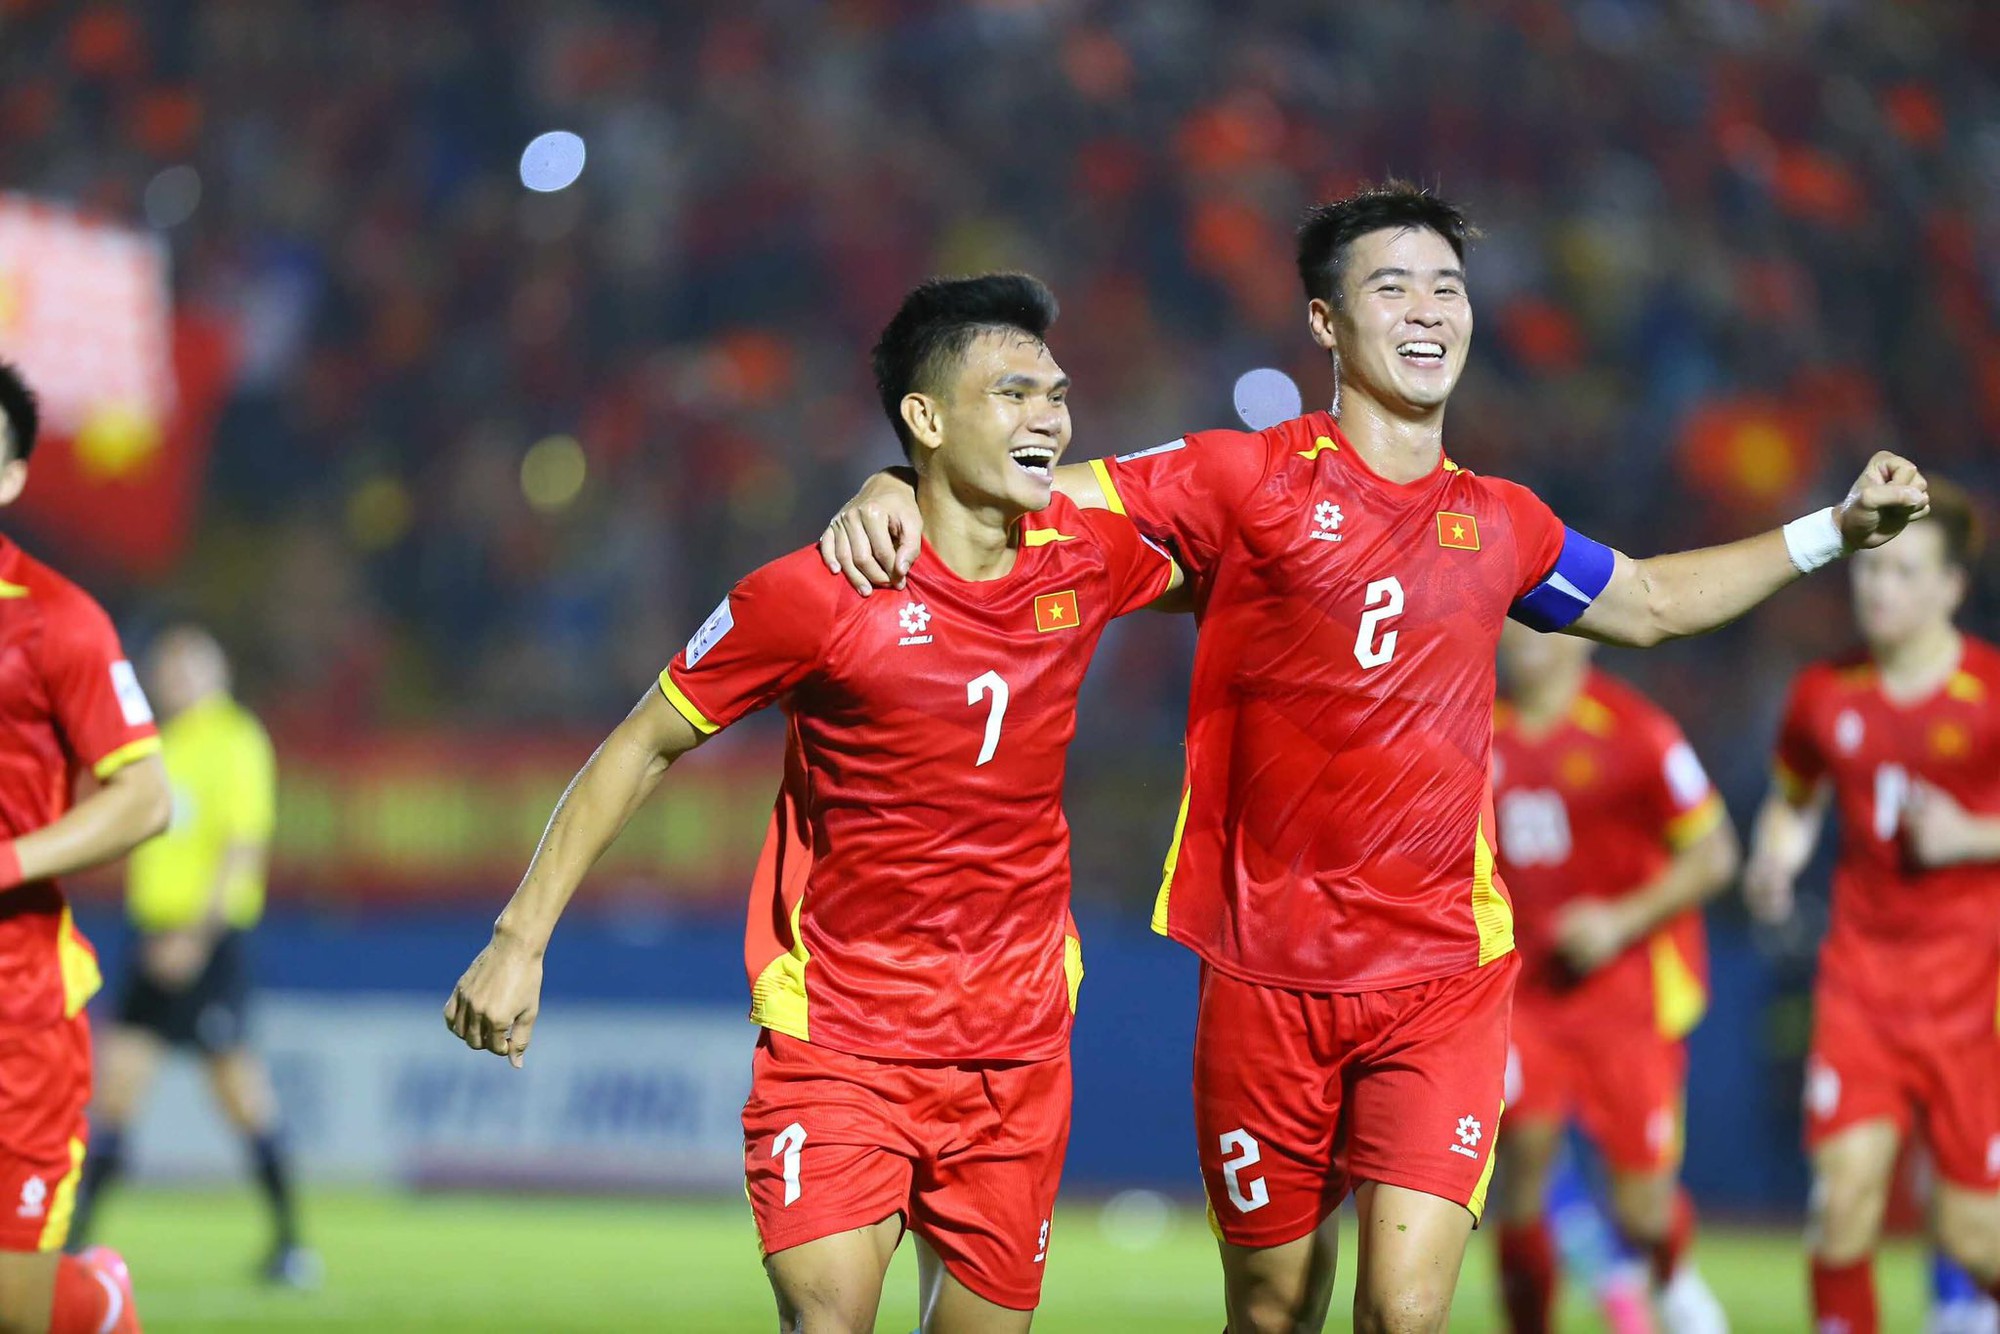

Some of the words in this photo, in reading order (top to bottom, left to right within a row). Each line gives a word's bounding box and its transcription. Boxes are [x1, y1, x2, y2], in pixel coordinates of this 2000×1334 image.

[1353, 576, 1405, 670] 2
[966, 670, 1010, 767] 7
[771, 1122, 808, 1207] 7
[1219, 1128, 1270, 1213] 2
